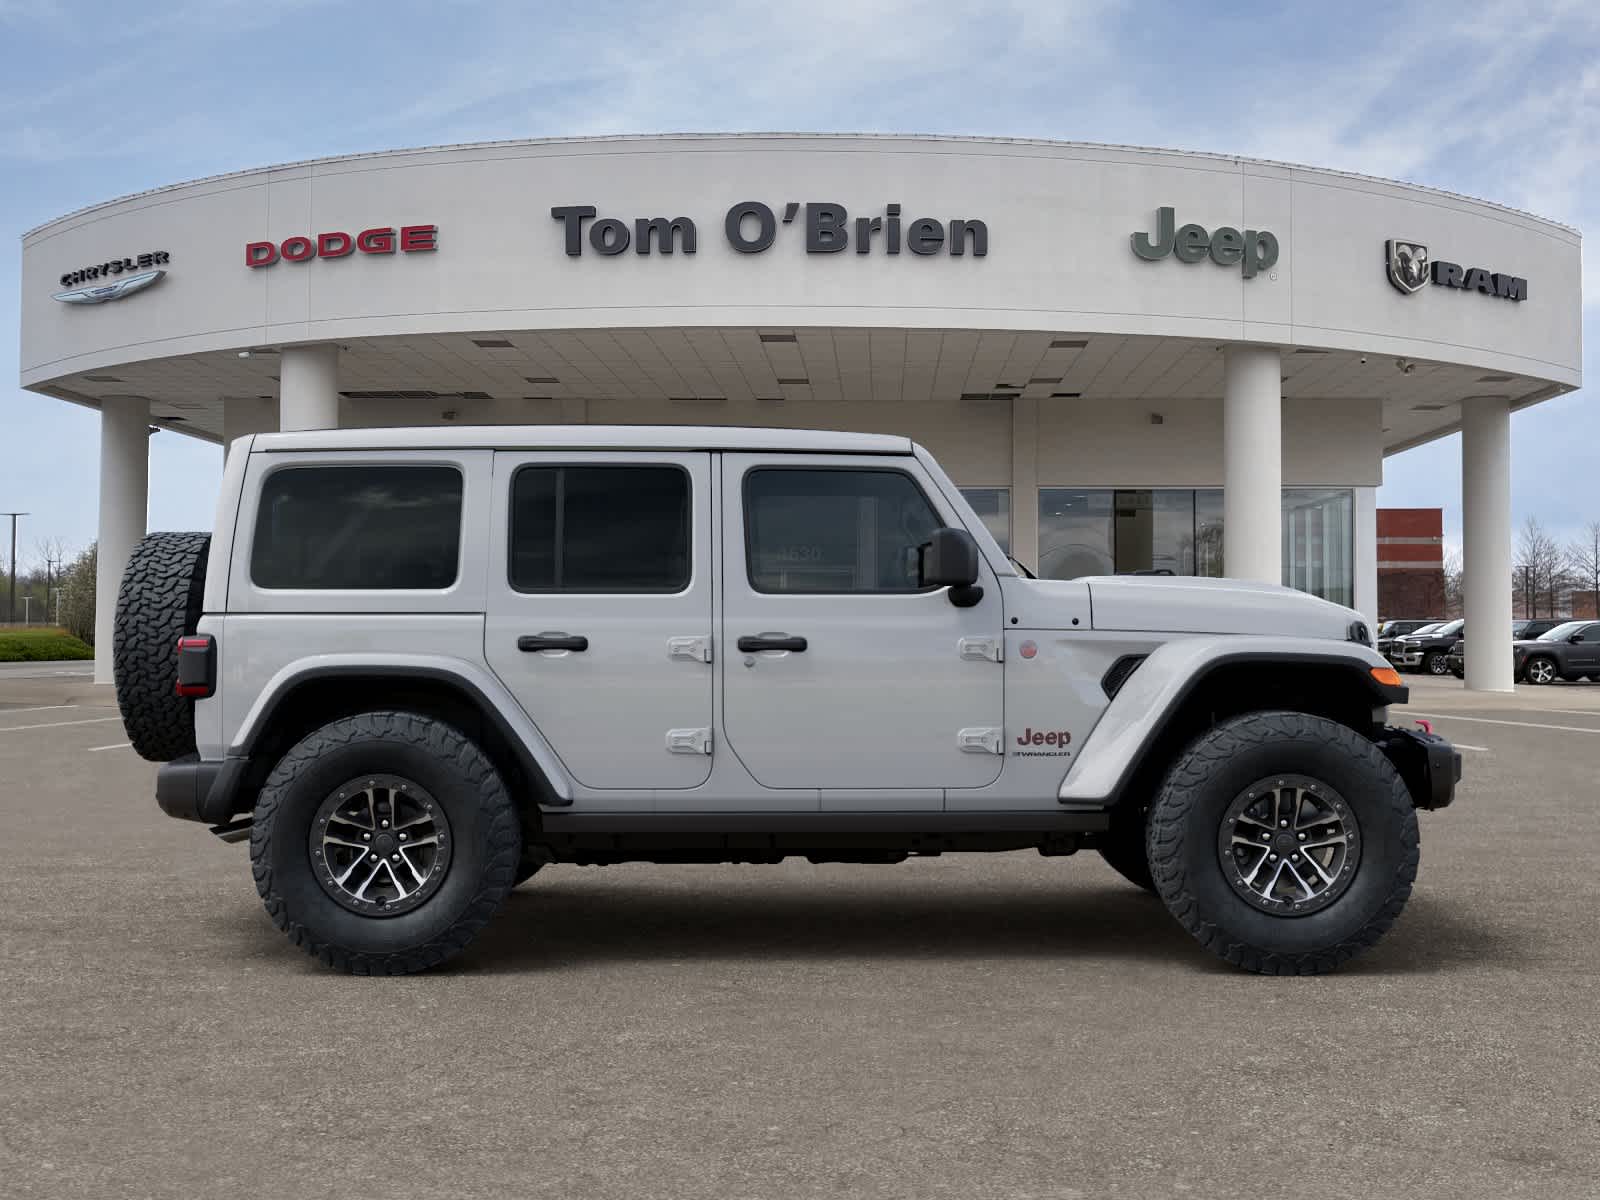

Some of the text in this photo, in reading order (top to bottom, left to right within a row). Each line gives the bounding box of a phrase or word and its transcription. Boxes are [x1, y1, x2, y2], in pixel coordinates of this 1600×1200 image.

[246, 225, 437, 268] DODGE
[551, 201, 988, 257] Tom O'Brien
[1131, 207, 1280, 279] Jeep
[60, 250, 169, 287] CHRYSLER
[1430, 261, 1528, 301] RAM
[1016, 727, 1072, 749] Jeep
